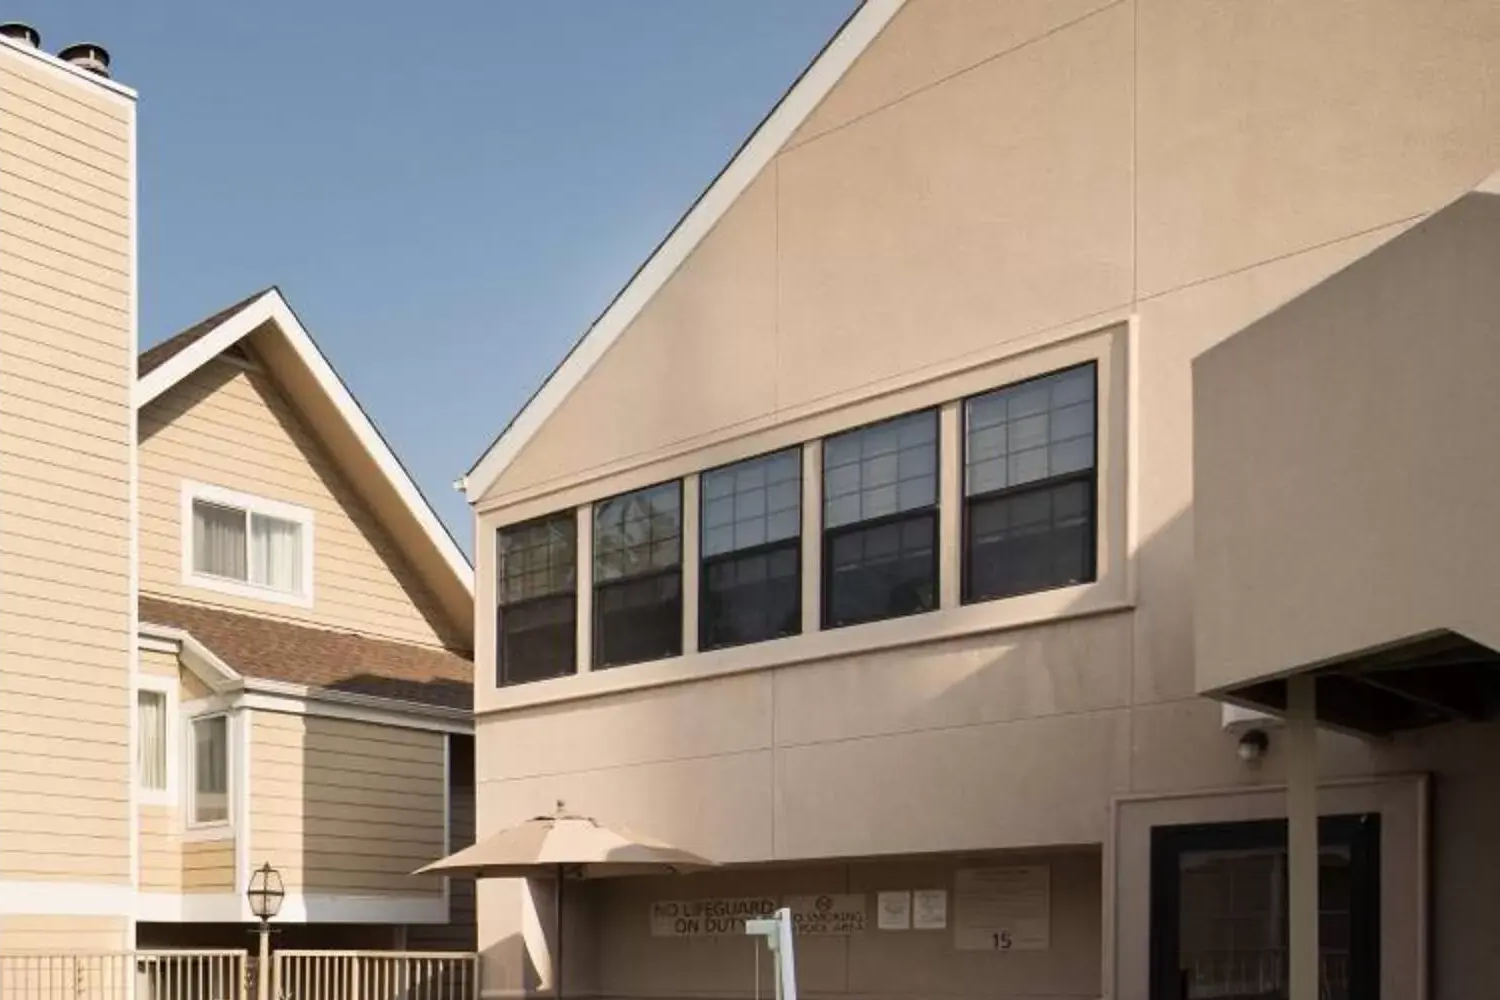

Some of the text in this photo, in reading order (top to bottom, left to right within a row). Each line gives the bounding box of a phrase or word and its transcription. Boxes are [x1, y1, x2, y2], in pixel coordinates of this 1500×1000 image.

[654, 899, 775, 917] NO LIFEGUARD
[675, 918, 699, 933] ON
[992, 929, 1013, 950] 15
